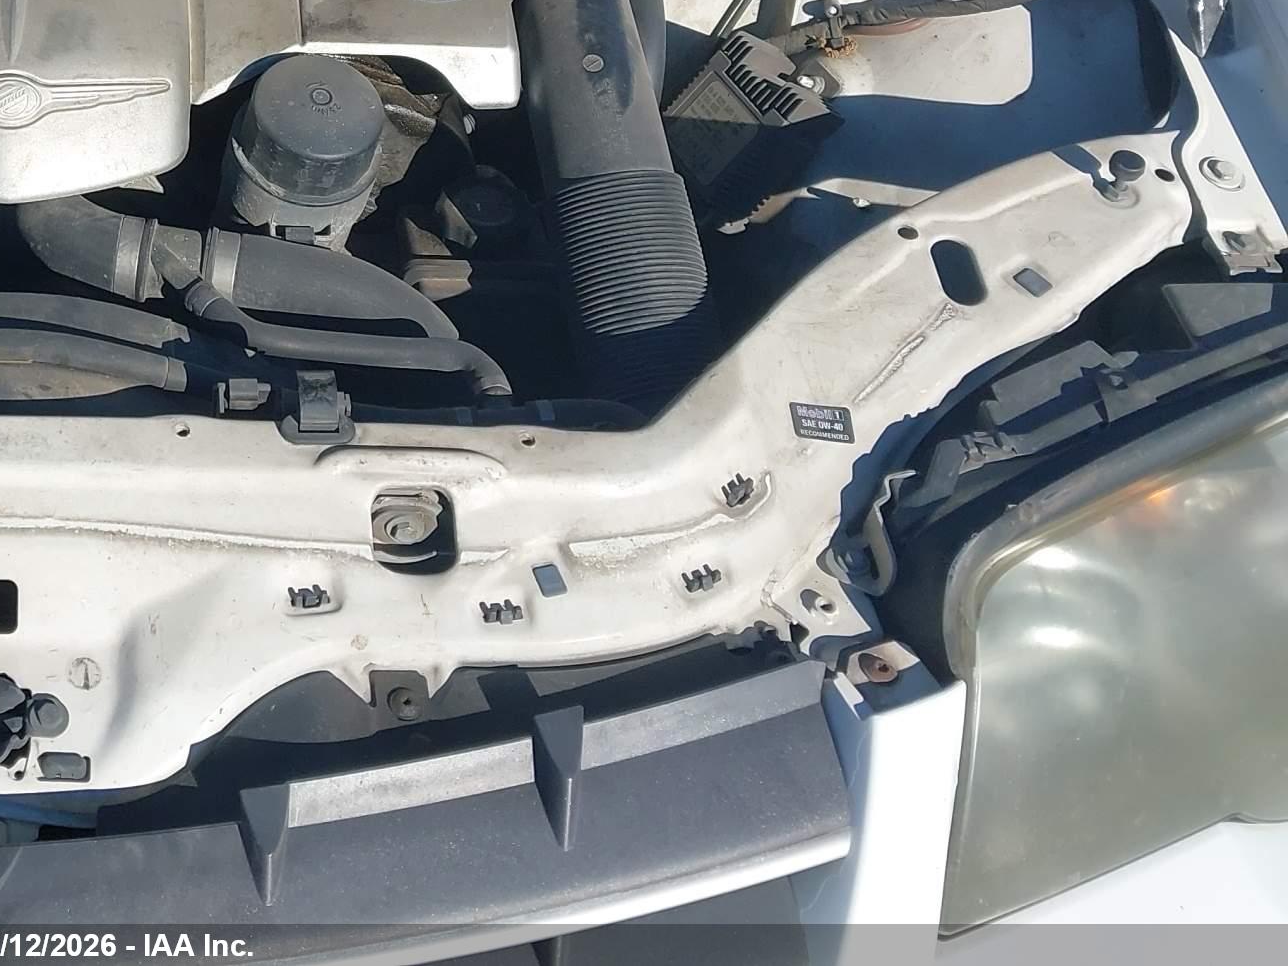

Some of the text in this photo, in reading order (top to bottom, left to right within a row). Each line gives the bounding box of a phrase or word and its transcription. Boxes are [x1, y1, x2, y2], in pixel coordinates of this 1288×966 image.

[797, 406, 833, 420] Mobil
[802, 419, 817, 428] SAE
[800, 429, 849, 440] RECOMMENDED
